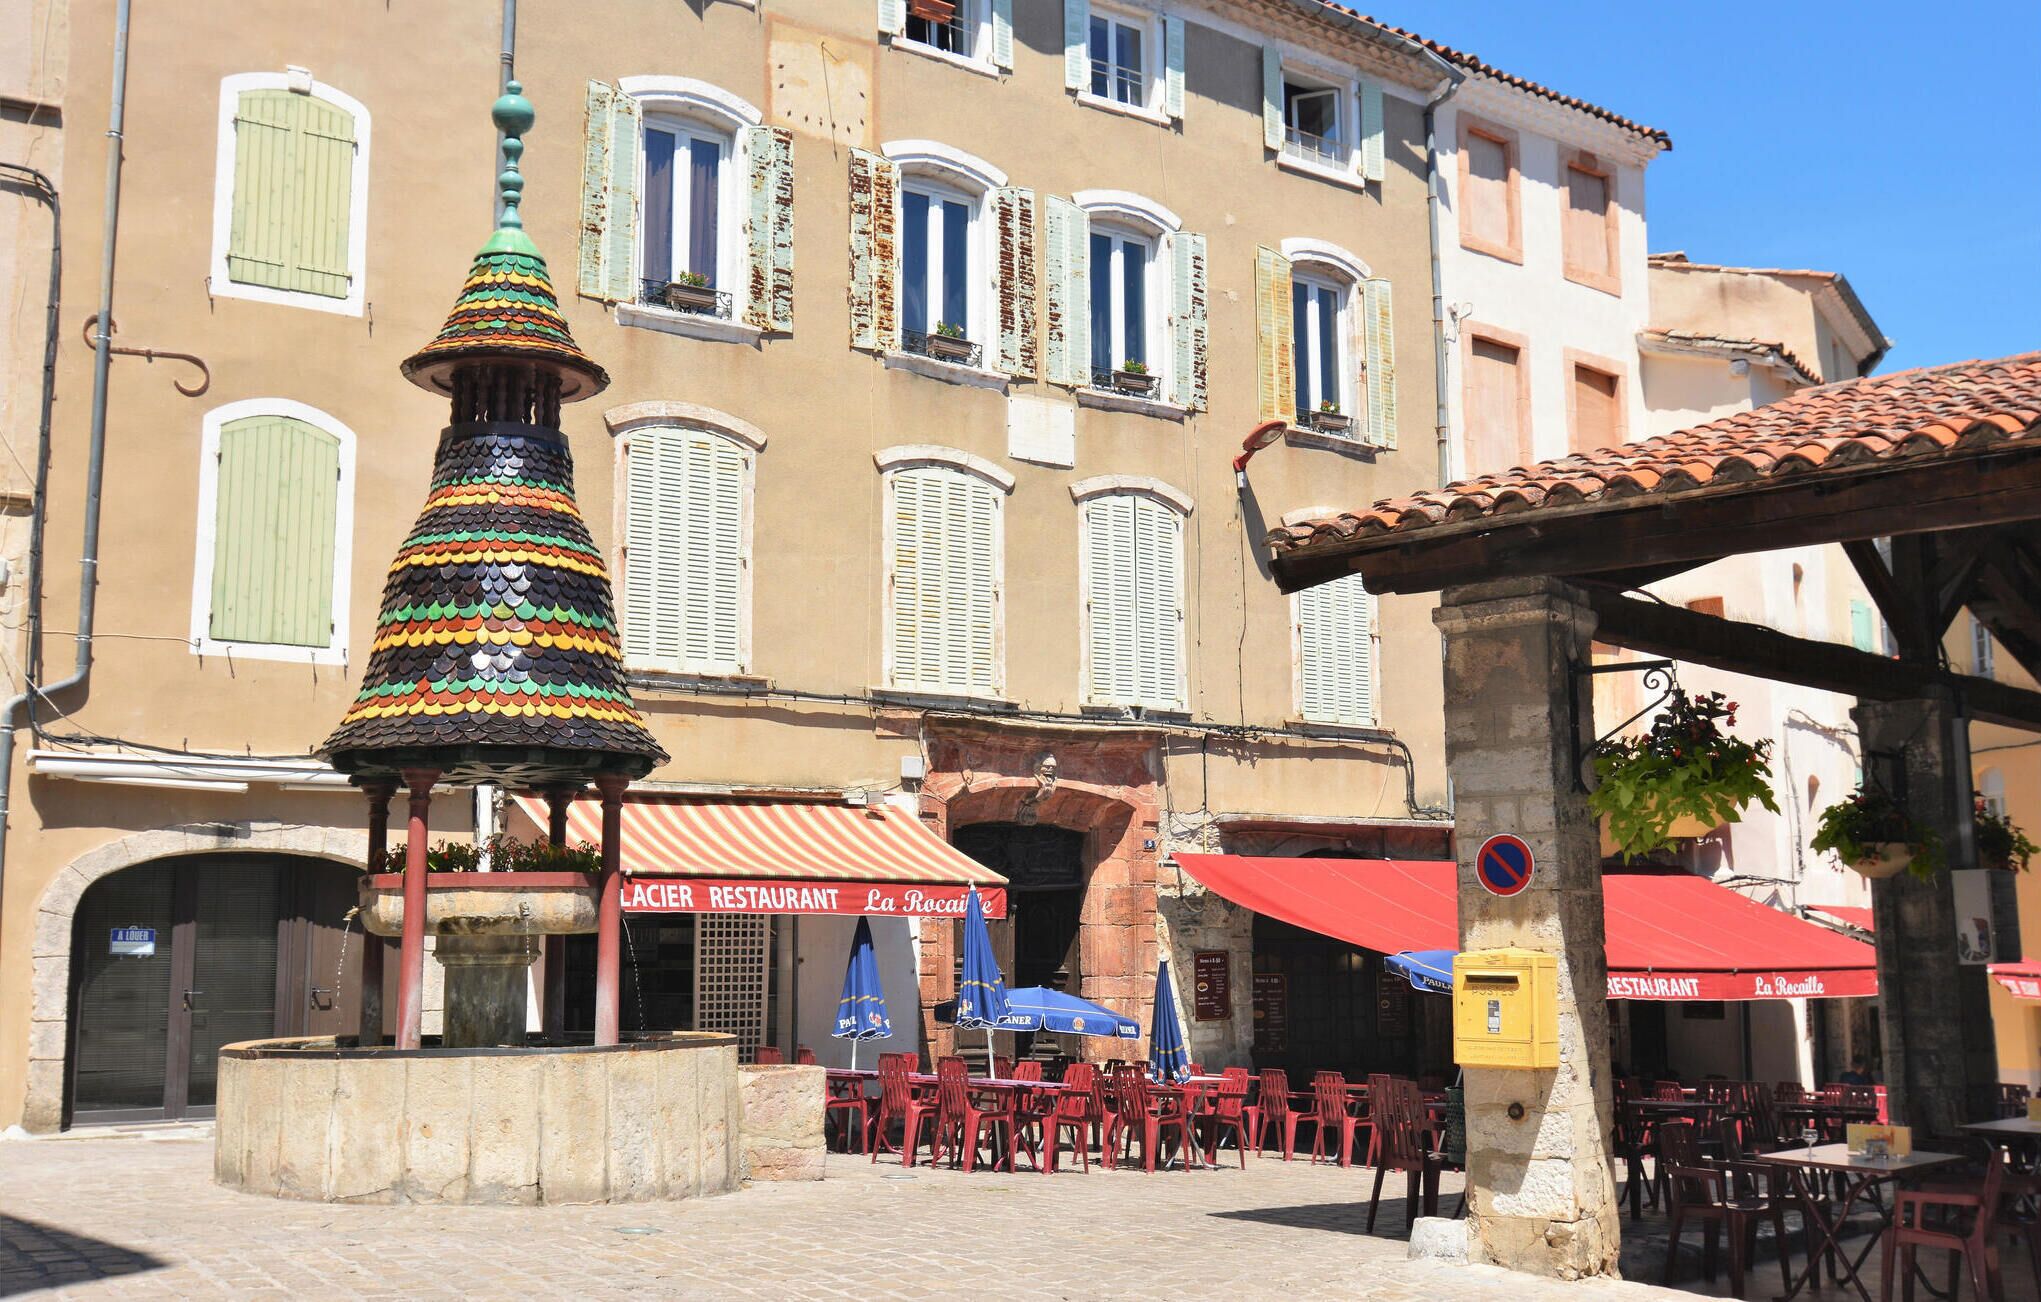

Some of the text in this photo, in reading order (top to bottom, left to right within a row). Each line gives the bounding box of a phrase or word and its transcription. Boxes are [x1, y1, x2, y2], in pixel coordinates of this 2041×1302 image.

[709, 886, 839, 909] RESTAURANT
[863, 888, 896, 912] La
[902, 889, 993, 914] Rocaie
[1755, 976, 1773, 995] La
[1775, 975, 1825, 995] Rocaille
